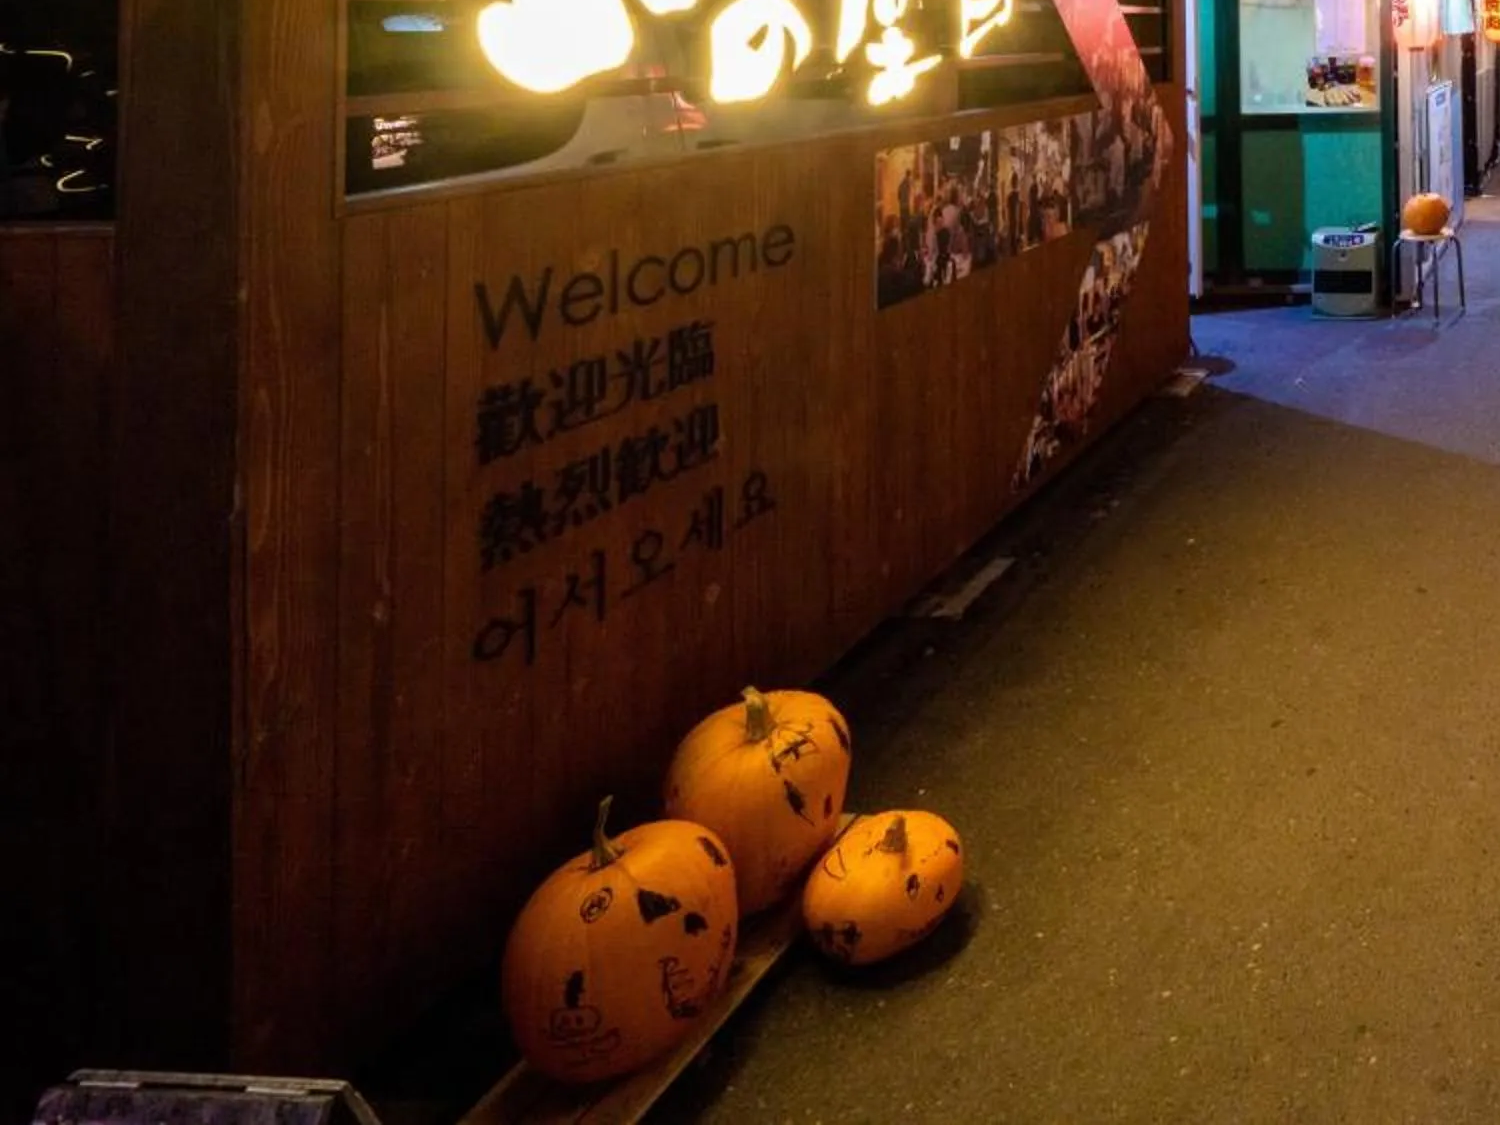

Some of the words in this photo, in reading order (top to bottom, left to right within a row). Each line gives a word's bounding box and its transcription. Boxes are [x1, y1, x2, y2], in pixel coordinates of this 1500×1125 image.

[474, 223, 796, 351] Welcome
[475, 320, 715, 466] 歡迎光臨
[472, 470, 777, 667] 어서오세요
